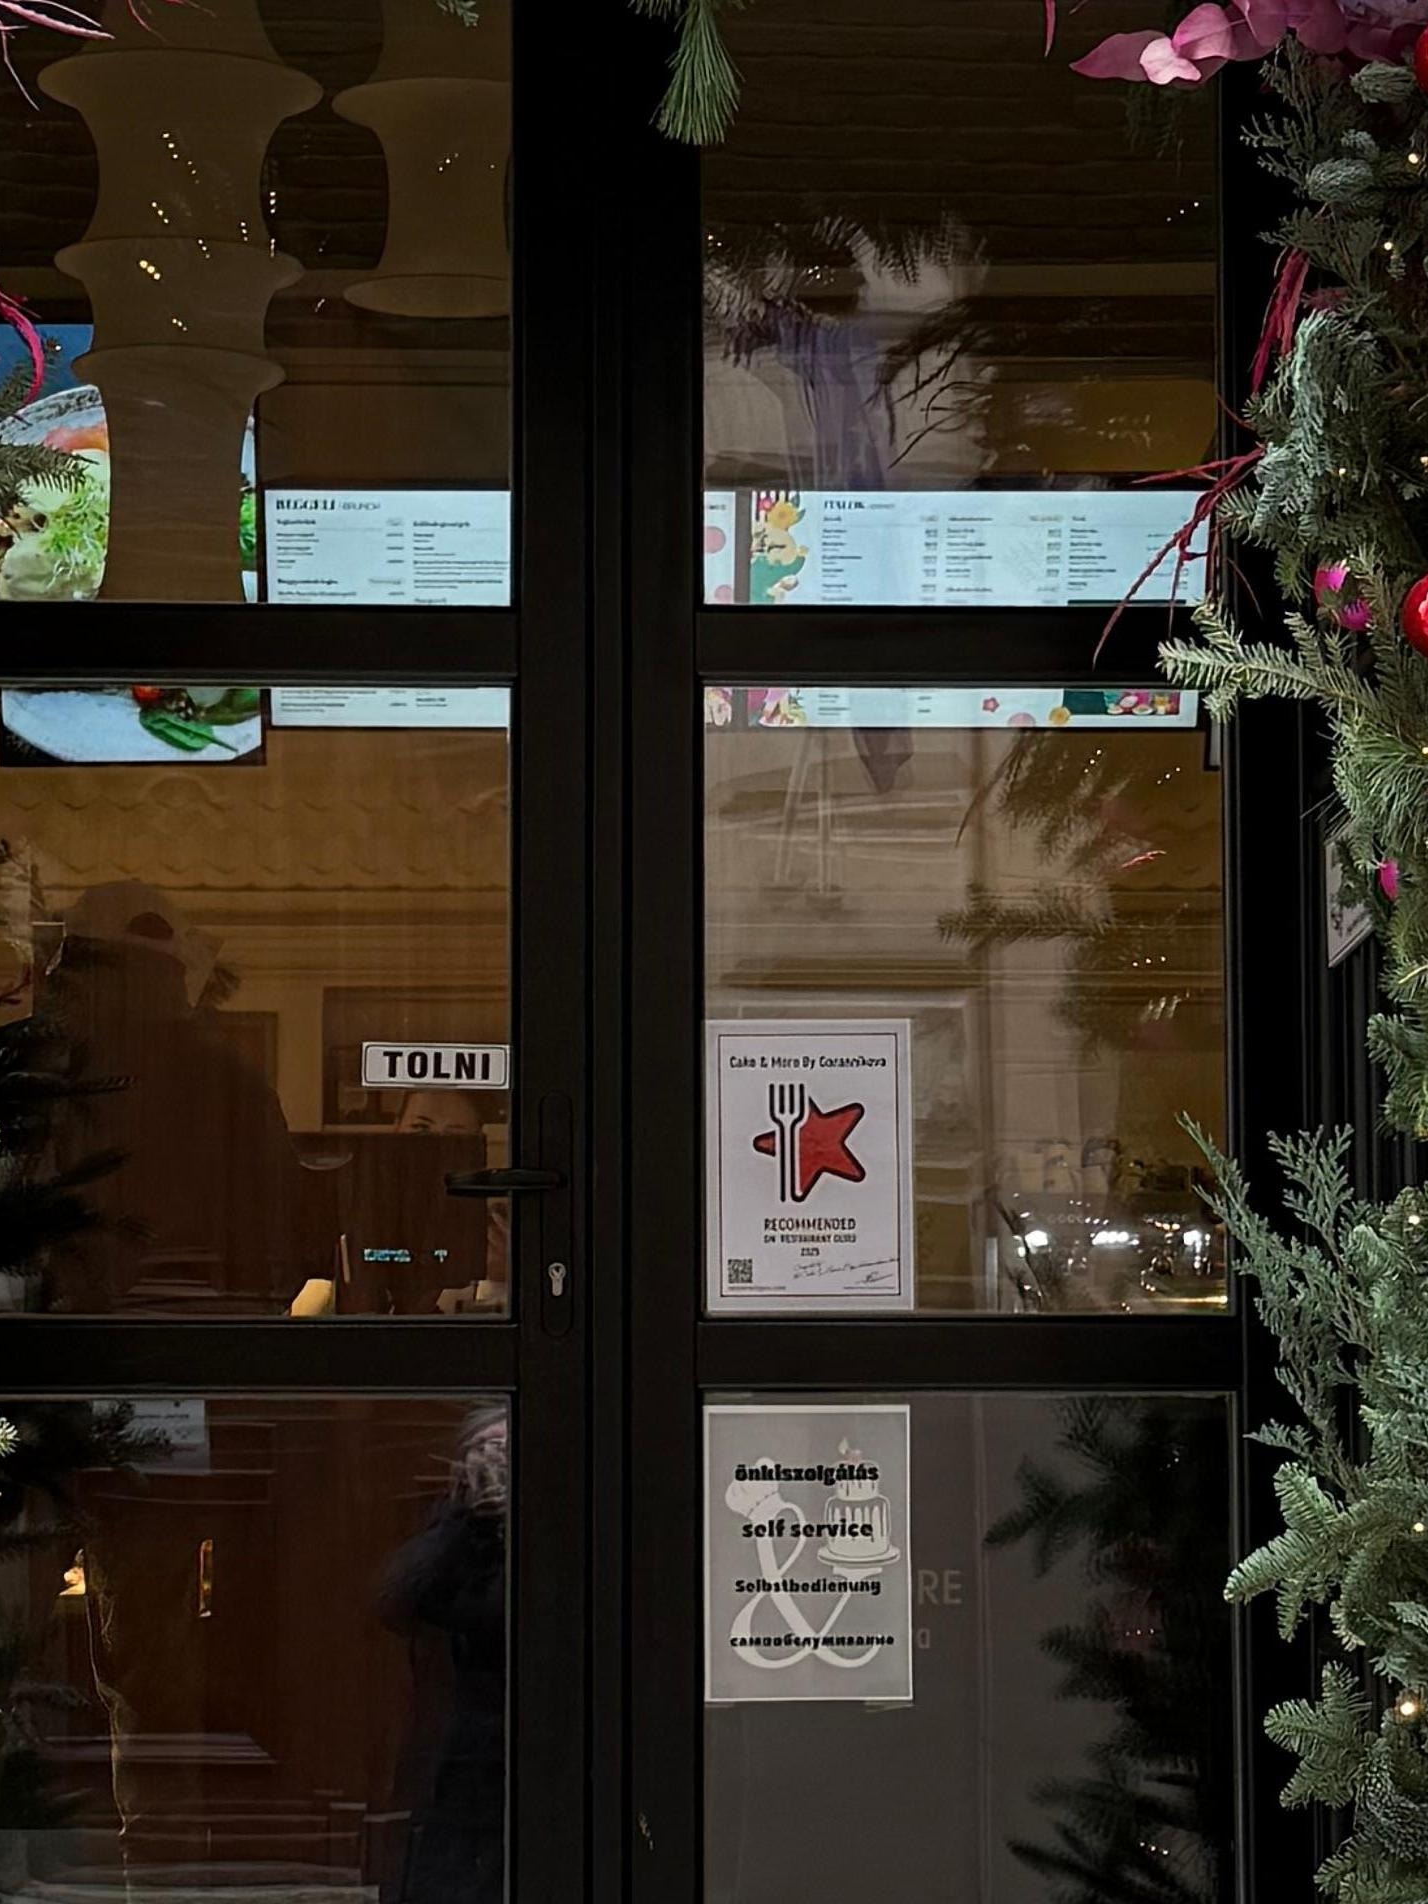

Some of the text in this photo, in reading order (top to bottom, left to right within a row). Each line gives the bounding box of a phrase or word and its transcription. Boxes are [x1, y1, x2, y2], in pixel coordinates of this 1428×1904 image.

[382, 1051, 491, 1080] TOLNI
[764, 1217, 857, 1232] RECOMMENDED
[735, 1463, 879, 1486] önkiszolgálás
[742, 1517, 874, 1538] self service
[735, 1578, 881, 1595] Selbstbedienung
